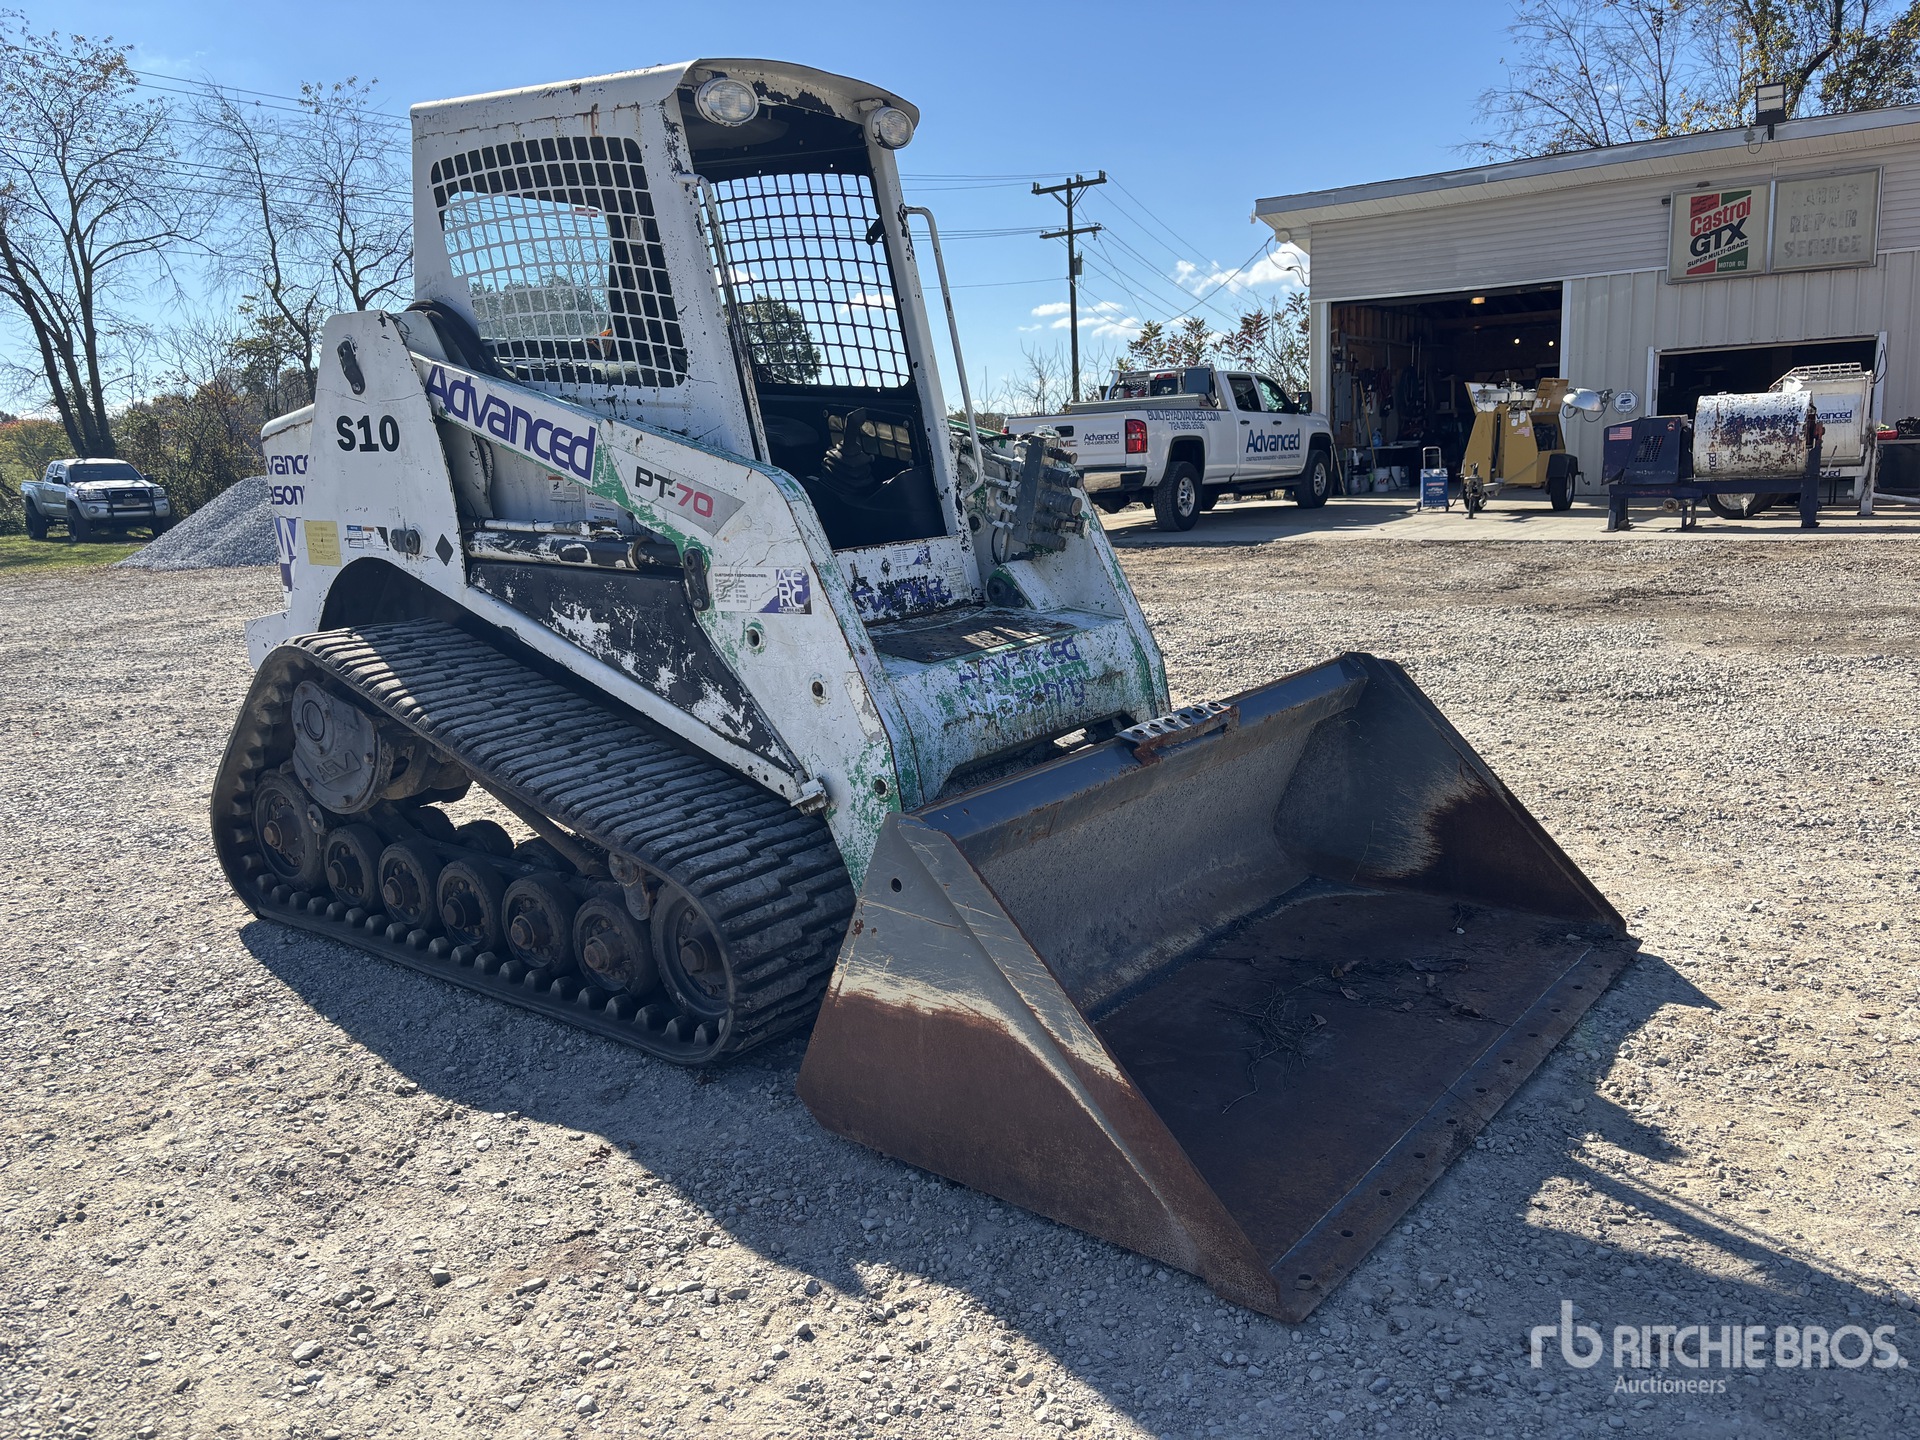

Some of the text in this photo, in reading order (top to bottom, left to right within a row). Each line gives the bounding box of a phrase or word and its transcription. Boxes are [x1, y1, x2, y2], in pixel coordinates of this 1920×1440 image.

[1690, 196, 1752, 237] Castrol
[1687, 240, 1749, 268] SUPER MULTI-GRADE
[1690, 217, 1748, 257] GTX
[336, 414, 401, 453] S10
[426, 364, 597, 481] Advanced
[1084, 431, 1120, 442] Advanced
[1245, 427, 1301, 453] Advanced
[269, 485, 305, 506] son
[634, 465, 715, 518] PT-70
